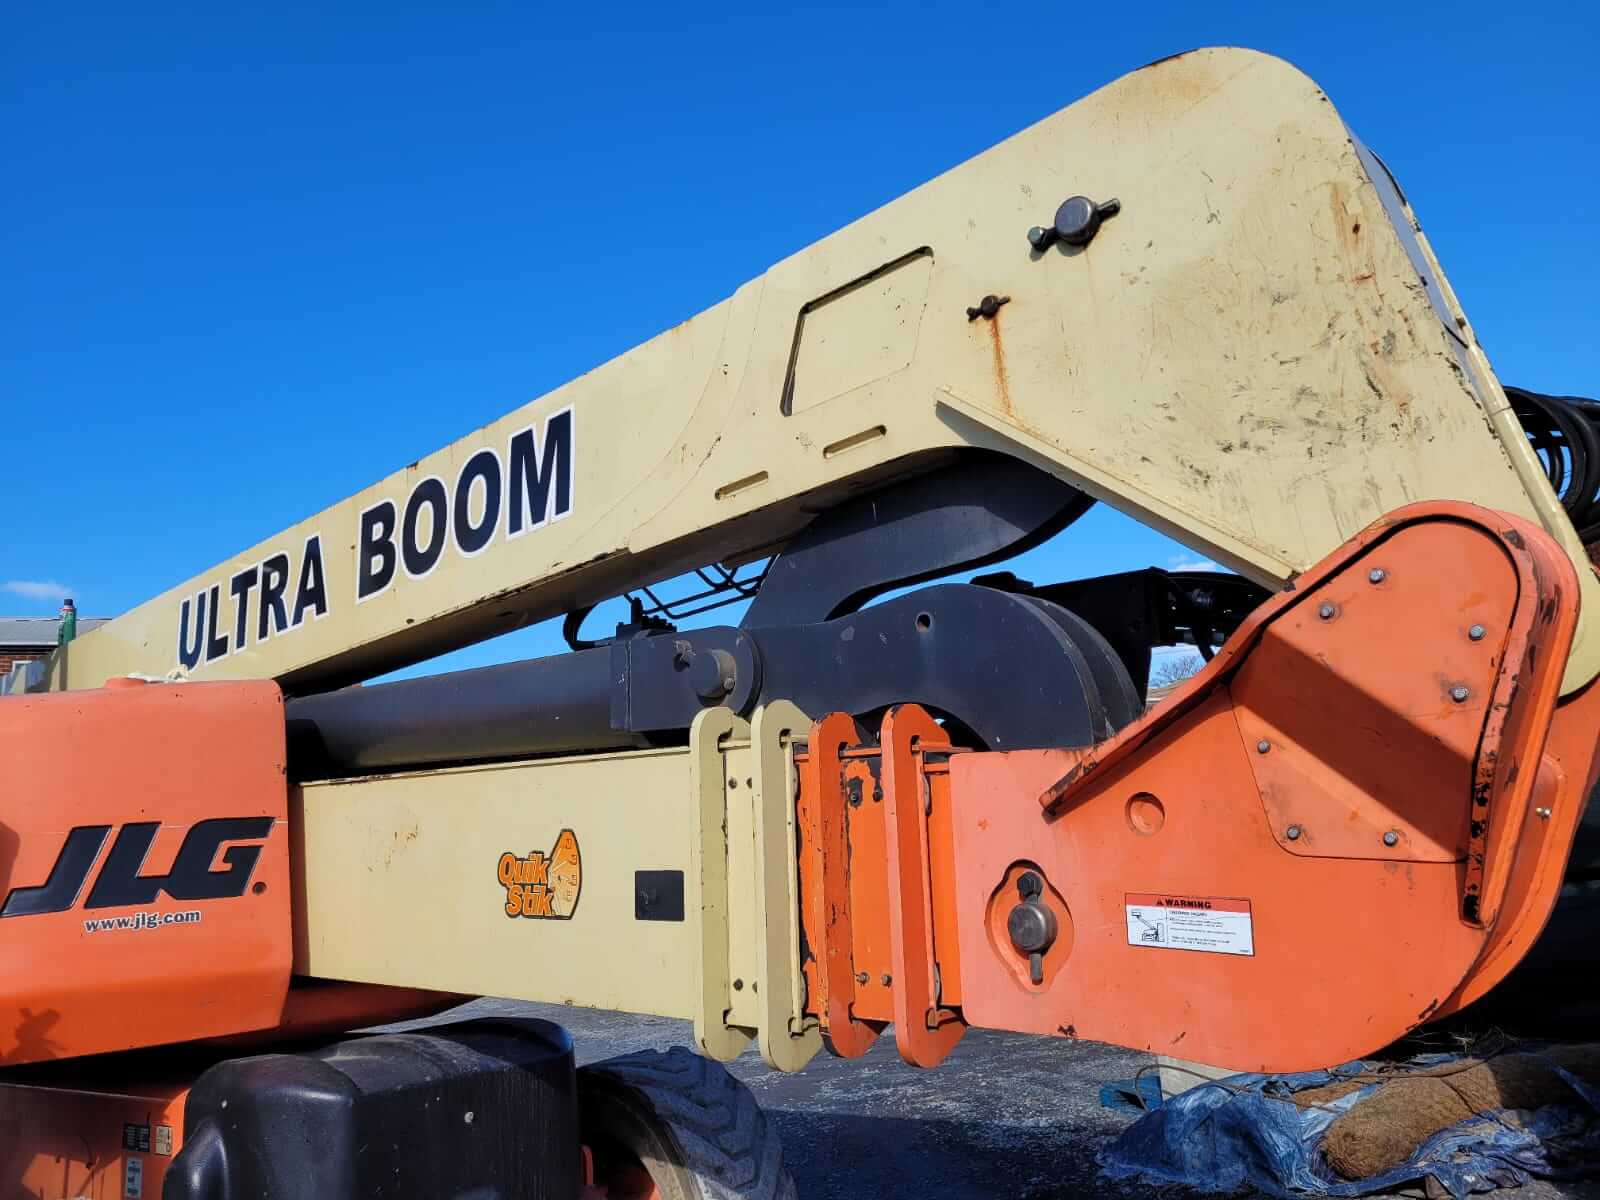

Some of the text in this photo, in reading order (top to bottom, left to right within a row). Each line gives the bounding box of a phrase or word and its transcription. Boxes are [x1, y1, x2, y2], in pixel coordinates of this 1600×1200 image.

[178, 407, 573, 670] ULTRA BOOM
[2, 816, 274, 917] JLG
[499, 851, 549, 887] Quik
[506, 884, 554, 917] Stik
[1166, 898, 1212, 910] WARNING
[85, 910, 201, 933] www.jlg.com
